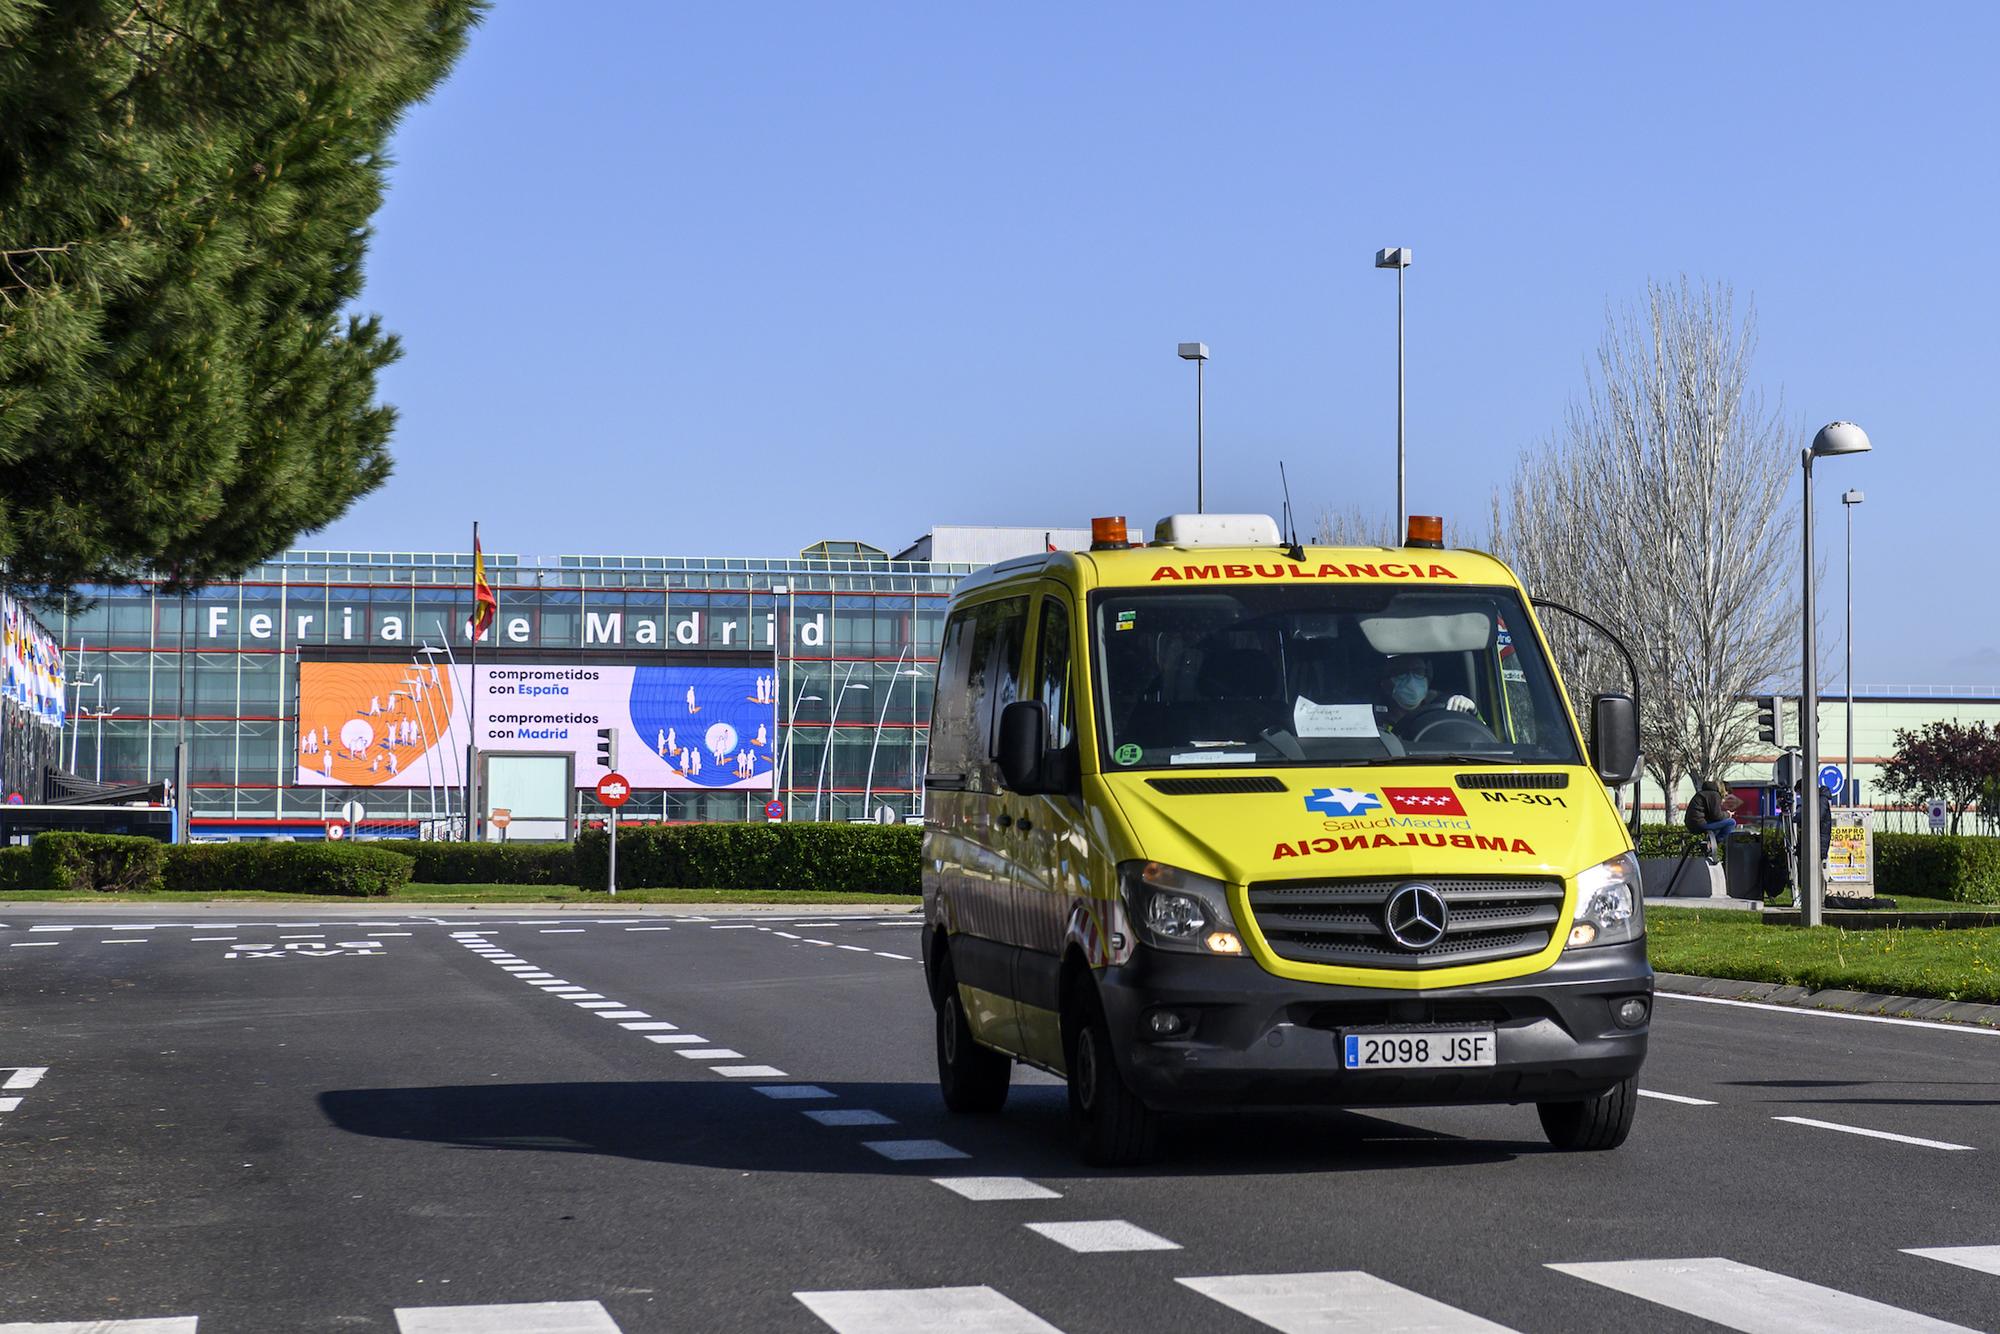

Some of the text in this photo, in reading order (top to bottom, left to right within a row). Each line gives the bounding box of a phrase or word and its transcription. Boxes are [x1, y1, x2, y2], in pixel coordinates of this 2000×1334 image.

[1151, 564, 1458, 581] AMBULANCIA
[208, 606, 403, 640] Feria
[585, 611, 824, 646] Madrid
[489, 669, 600, 681] comprometidos
[489, 684, 569, 697] con España
[488, 713, 599, 725] comprometidos
[488, 728, 568, 739] con Madrid
[1481, 791, 1568, 808] M-301
[1365, 1039, 1429, 1064] 2098
[1442, 1037, 1488, 1062] JSF
